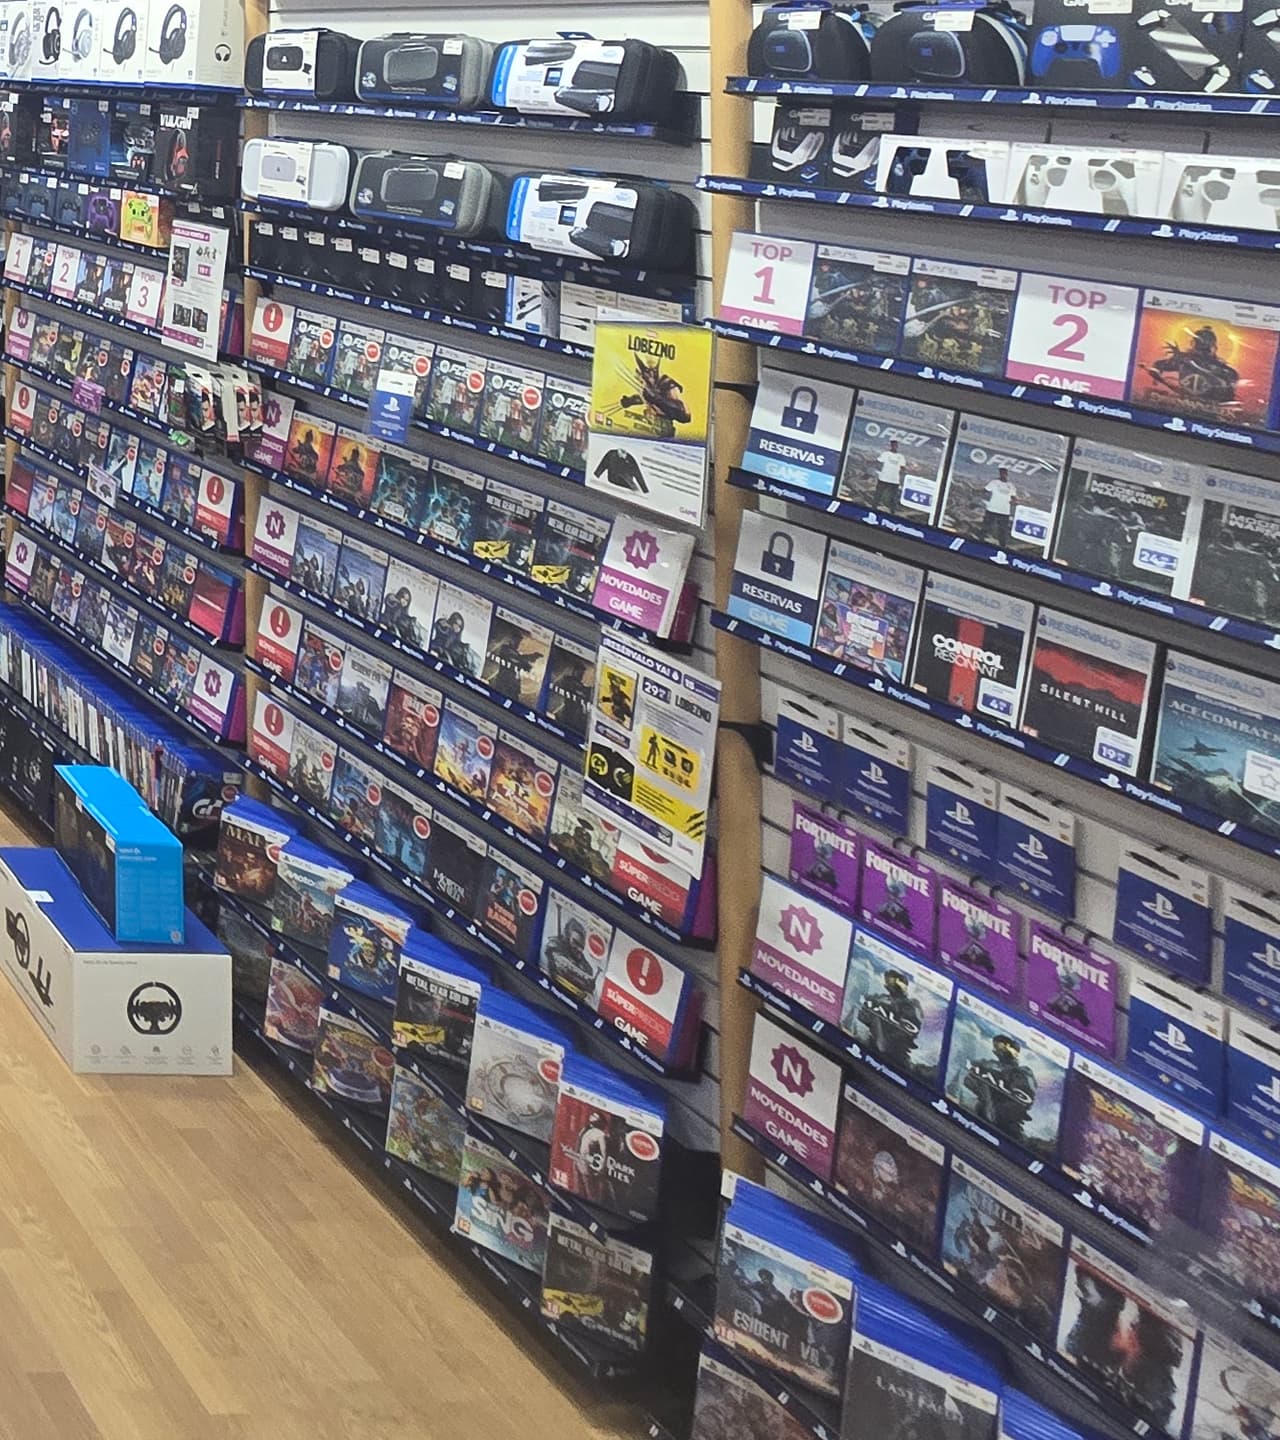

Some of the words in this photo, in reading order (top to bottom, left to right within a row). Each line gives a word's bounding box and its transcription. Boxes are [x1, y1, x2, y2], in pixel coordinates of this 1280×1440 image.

[1153, 100, 1212, 112] PlayStation
[750, 240, 794, 262] TOP
[1178, 229, 1239, 243] PlayStation
[752, 267, 776, 304] 1
[1047, 283, 1108, 310] TOP
[627, 334, 676, 361] LOBEZNO
[1047, 315, 1089, 362] 2
[937, 369, 984, 388] PlayStation
[1077, 399, 1132, 420] PlayStation
[1191, 423, 1253, 445] PlayStation
[759, 438, 826, 468] RESERVAS
[766, 462, 808, 486] GAME
[600, 571, 663, 607] NOVEDADES
[741, 582, 803, 615] RESERVAS
[609, 594, 644, 620] GAME
[932, 632, 1004, 672] CONTROL
[934, 646, 999, 678] RESONANT
[655, 661, 671, 678] YA!
[1040, 682, 1092, 713] SILENT
[1094, 701, 1128, 723] HILL
[1204, 707, 1271, 743] COMBAT
[795, 812, 856, 861] FORTNITE
[864, 848, 931, 897] FORTNITE
[627, 886, 662, 916] GAME
[756, 949, 837, 1005] NOVEDADES
[749, 1085, 830, 1150] NOVEDADES
[765, 1119, 809, 1160] GAME
[606, 1157, 636, 1177] DARK
[607, 1166, 631, 1185] TIES
[1098, 1202, 1152, 1247] PlayStation
